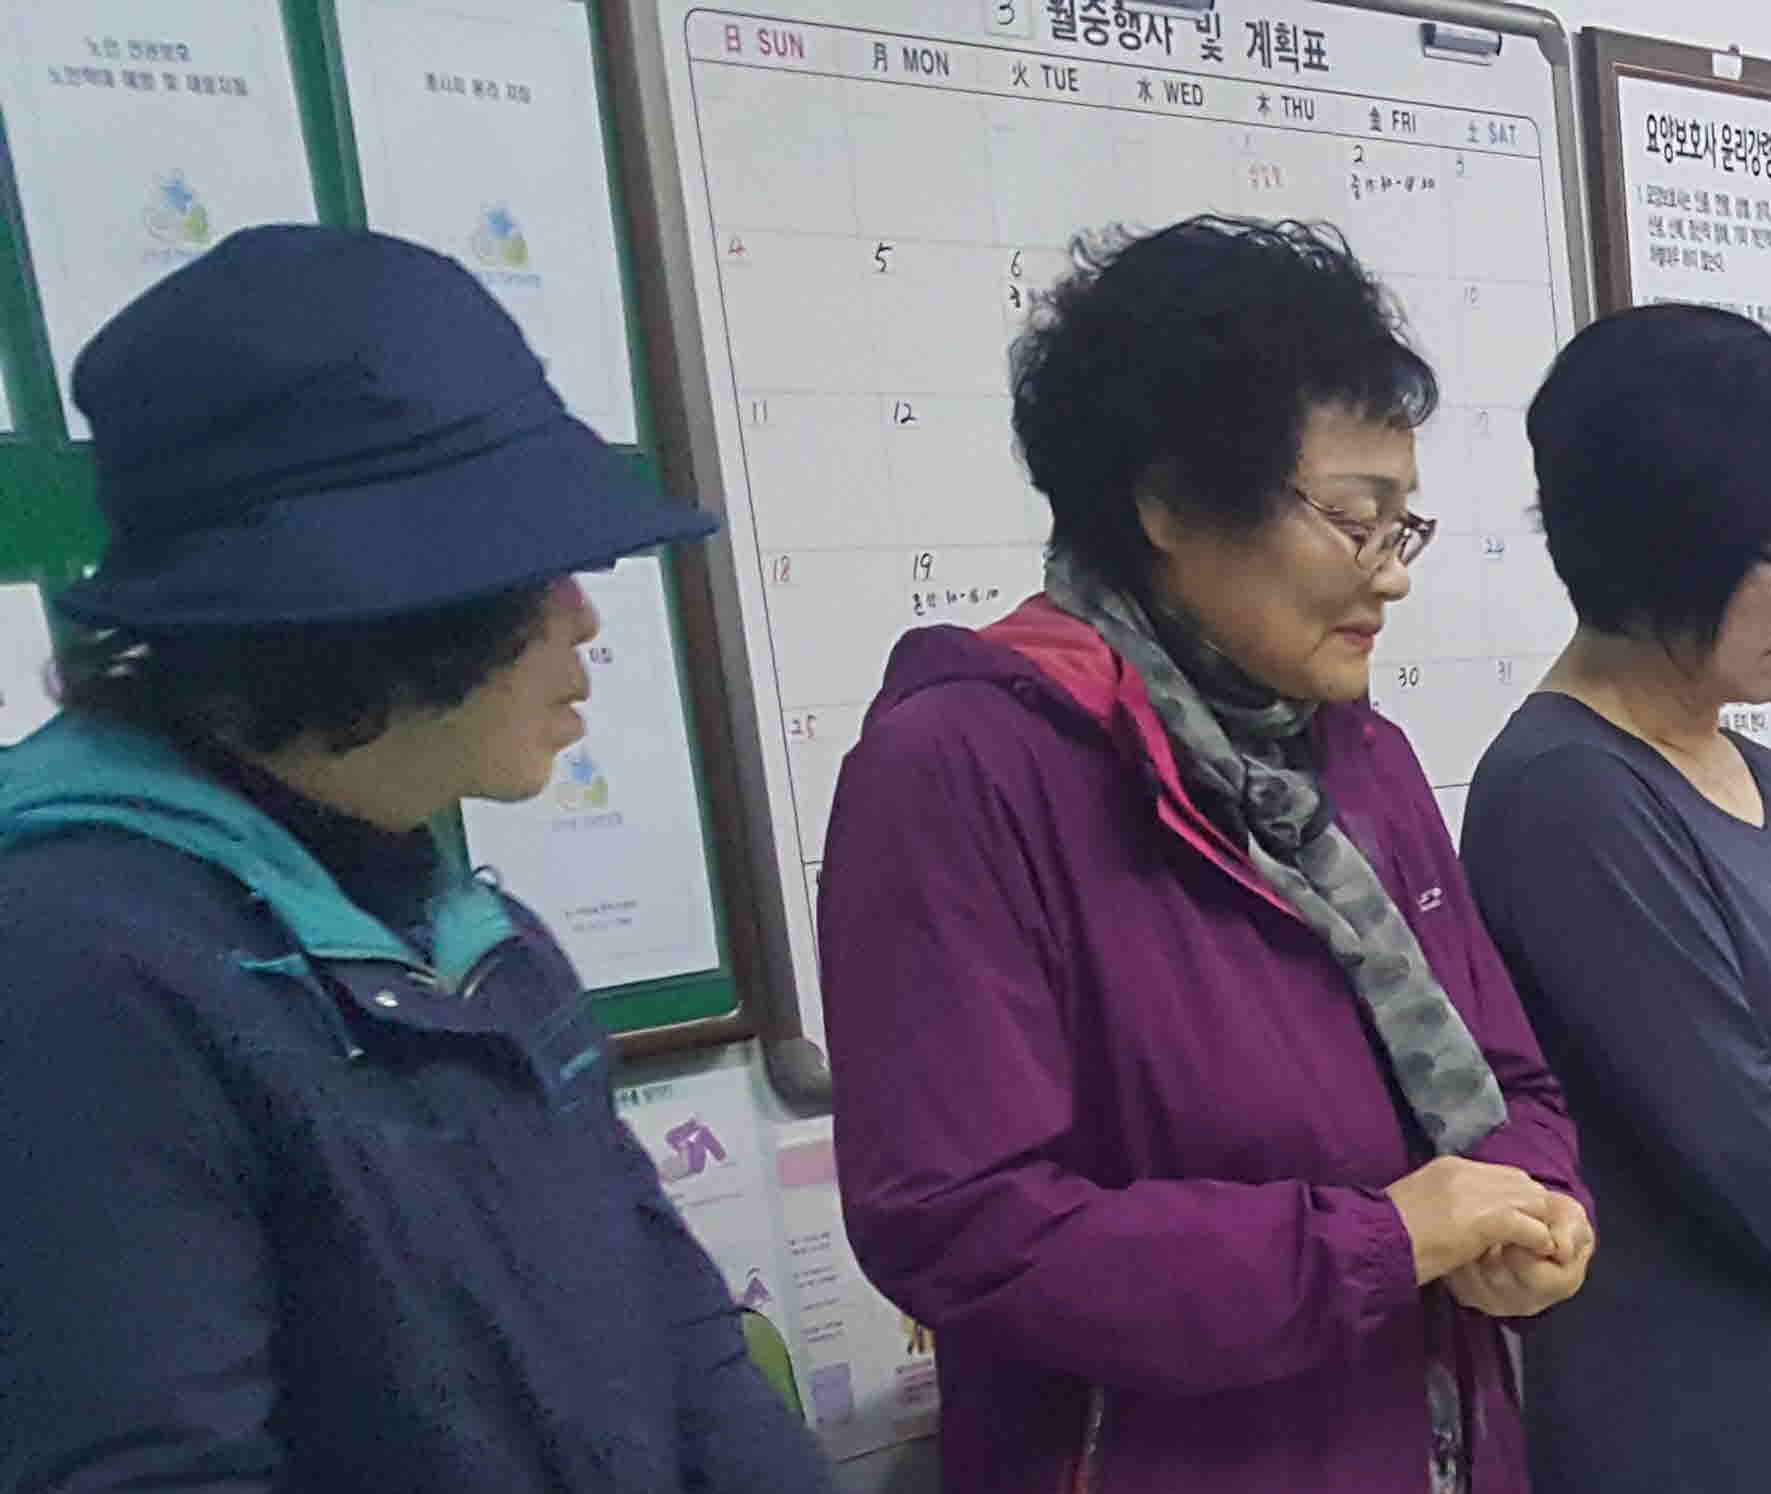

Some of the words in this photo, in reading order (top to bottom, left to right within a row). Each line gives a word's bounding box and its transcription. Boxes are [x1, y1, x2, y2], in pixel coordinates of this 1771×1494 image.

[725, 24, 741, 52] 日
[757, 29, 805, 59] SUN
[1246, 20, 1330, 73] 계획표
[873, 42, 888, 73] 月
[902, 47, 950, 77] MON
[1011, 60, 1030, 88] 火
[1040, 64, 1080, 92] TUE
[1137, 79, 1153, 103] 水
[1164, 83, 1204, 107] WED
[1281, 95, 1316, 121] THU
[1392, 110, 1417, 133] FRI
[1488, 123, 1517, 145] SAT
[1646, 113, 1718, 168] 요양보호사
[1352, 144, 1364, 163] 2
[874, 241, 893, 273] 5
[1010, 250, 1022, 277] 6
[752, 400, 768, 425] 11
[893, 400, 918, 425] 12
[771, 555, 791, 583] 18
[912, 552, 934, 581] 19
[1398, 666, 1420, 688] 30
